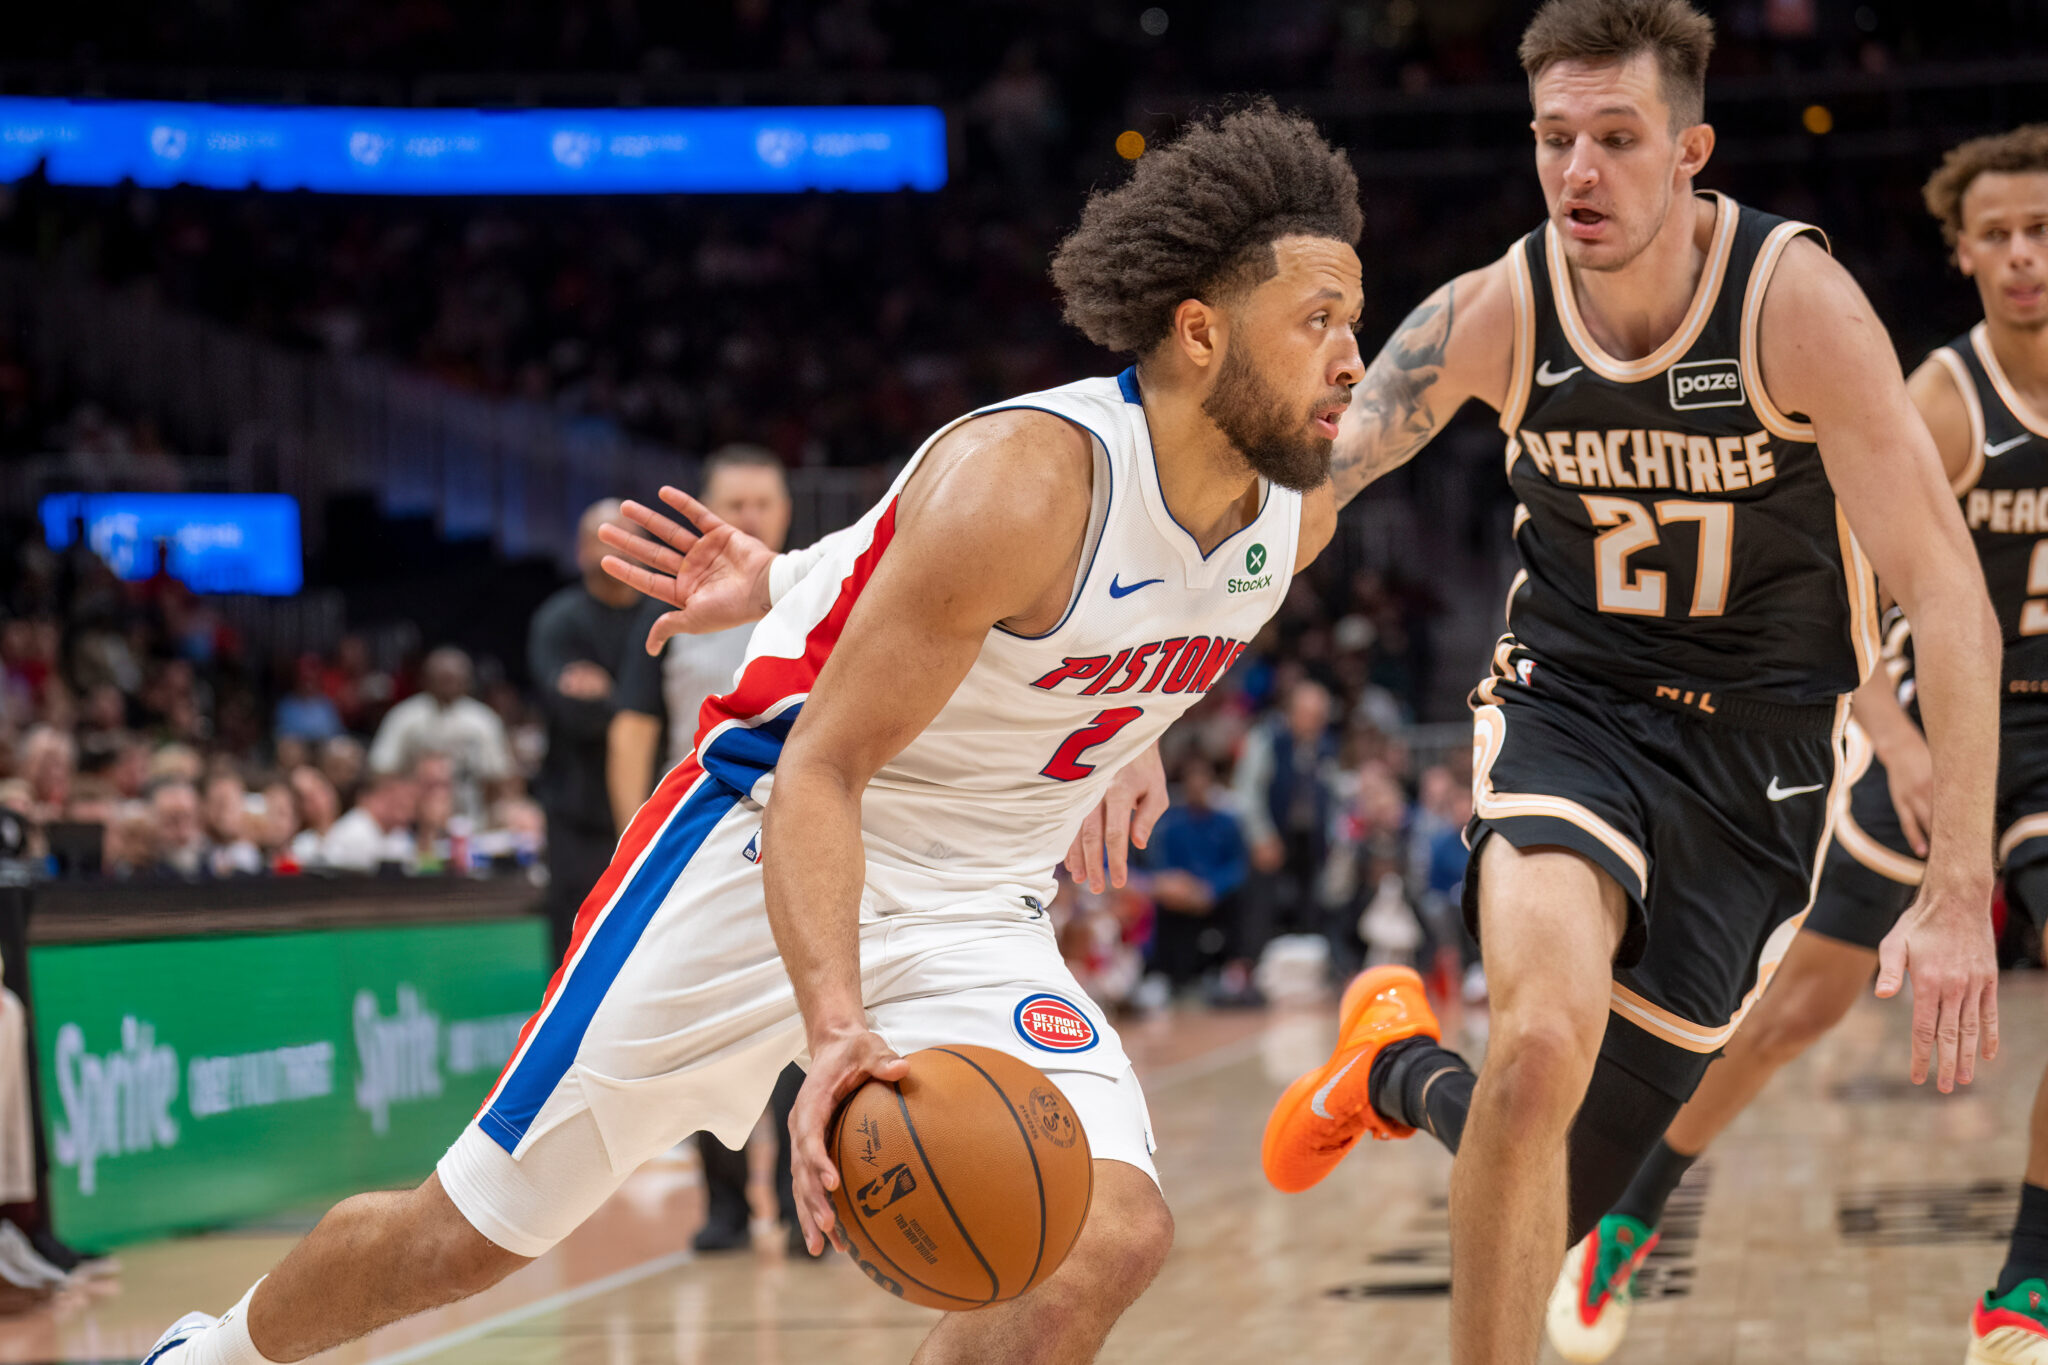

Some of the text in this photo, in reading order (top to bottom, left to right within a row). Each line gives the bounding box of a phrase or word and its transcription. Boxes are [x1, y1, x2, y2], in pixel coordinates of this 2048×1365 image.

[1677, 372, 1738, 398] paze
[1519, 429, 1776, 493] PEACHTREE
[1578, 493, 1734, 618] 27
[1227, 574, 1273, 594] StockX
[1038, 705, 1144, 781] 2
[1031, 1012, 1081, 1029] DETROIT
[1032, 1020, 1084, 1038] PISTONS
